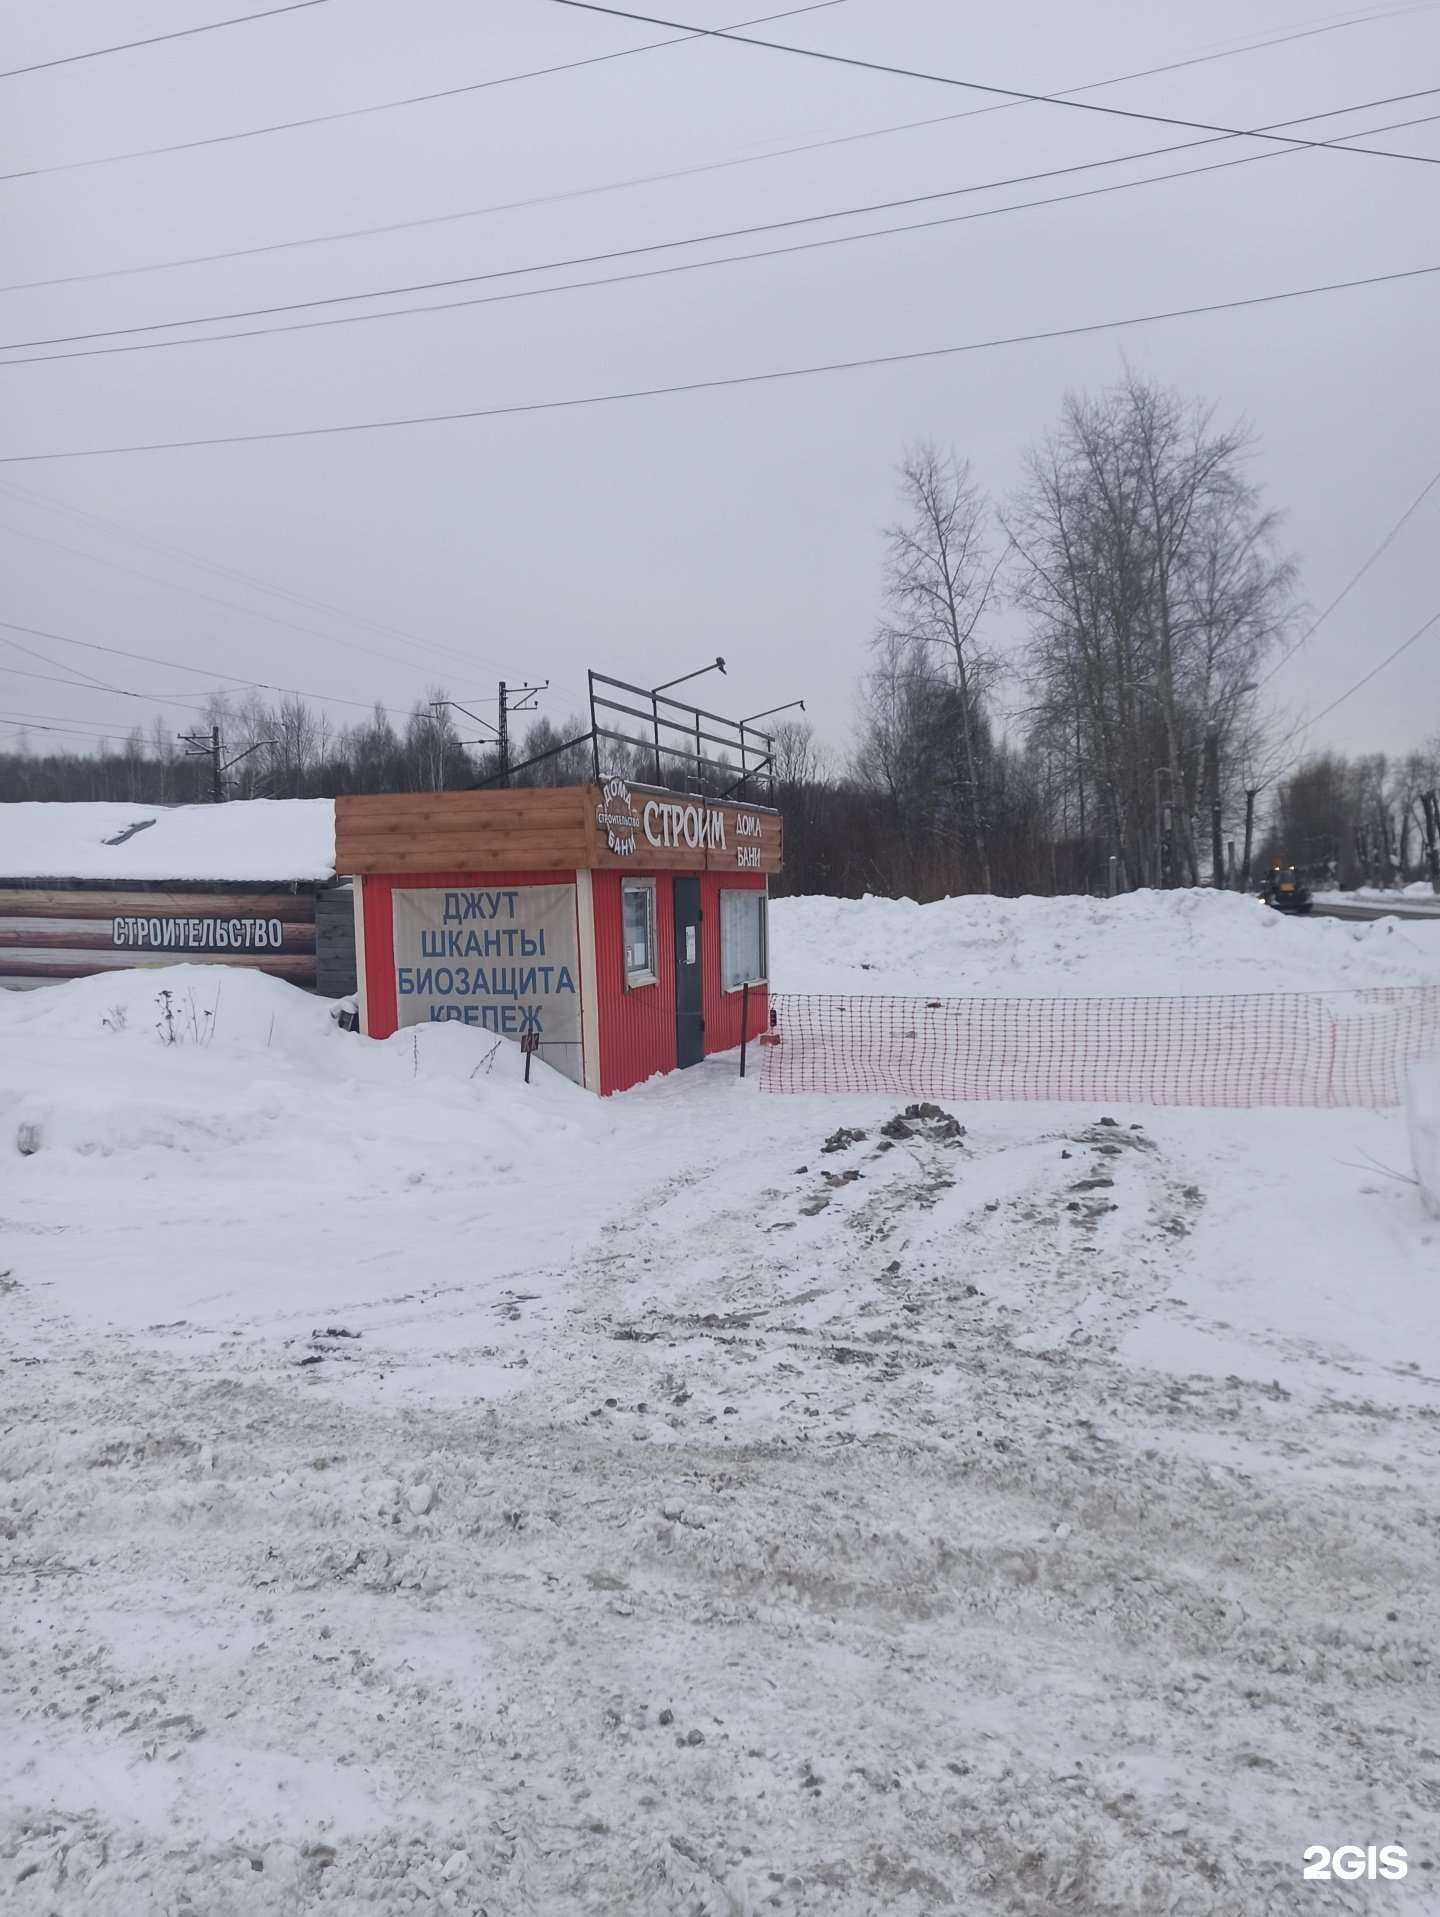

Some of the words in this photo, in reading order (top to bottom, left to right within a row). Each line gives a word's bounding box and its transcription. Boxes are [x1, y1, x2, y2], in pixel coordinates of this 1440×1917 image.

[603, 780, 632, 809] ДОМА
[643, 800, 727, 850] СТРОИМ
[736, 813, 762, 837] ДОМА
[608, 830, 637, 856] БАНИ
[737, 846, 761, 867] БАНИ
[442, 891, 519, 925] ДЖУТ
[112, 917, 283, 947] СТРОИТЕЛЬСТВО
[421, 928, 546, 958] ШКАНТЫ
[398, 966, 576, 1000] БИОЗАЩИТА
